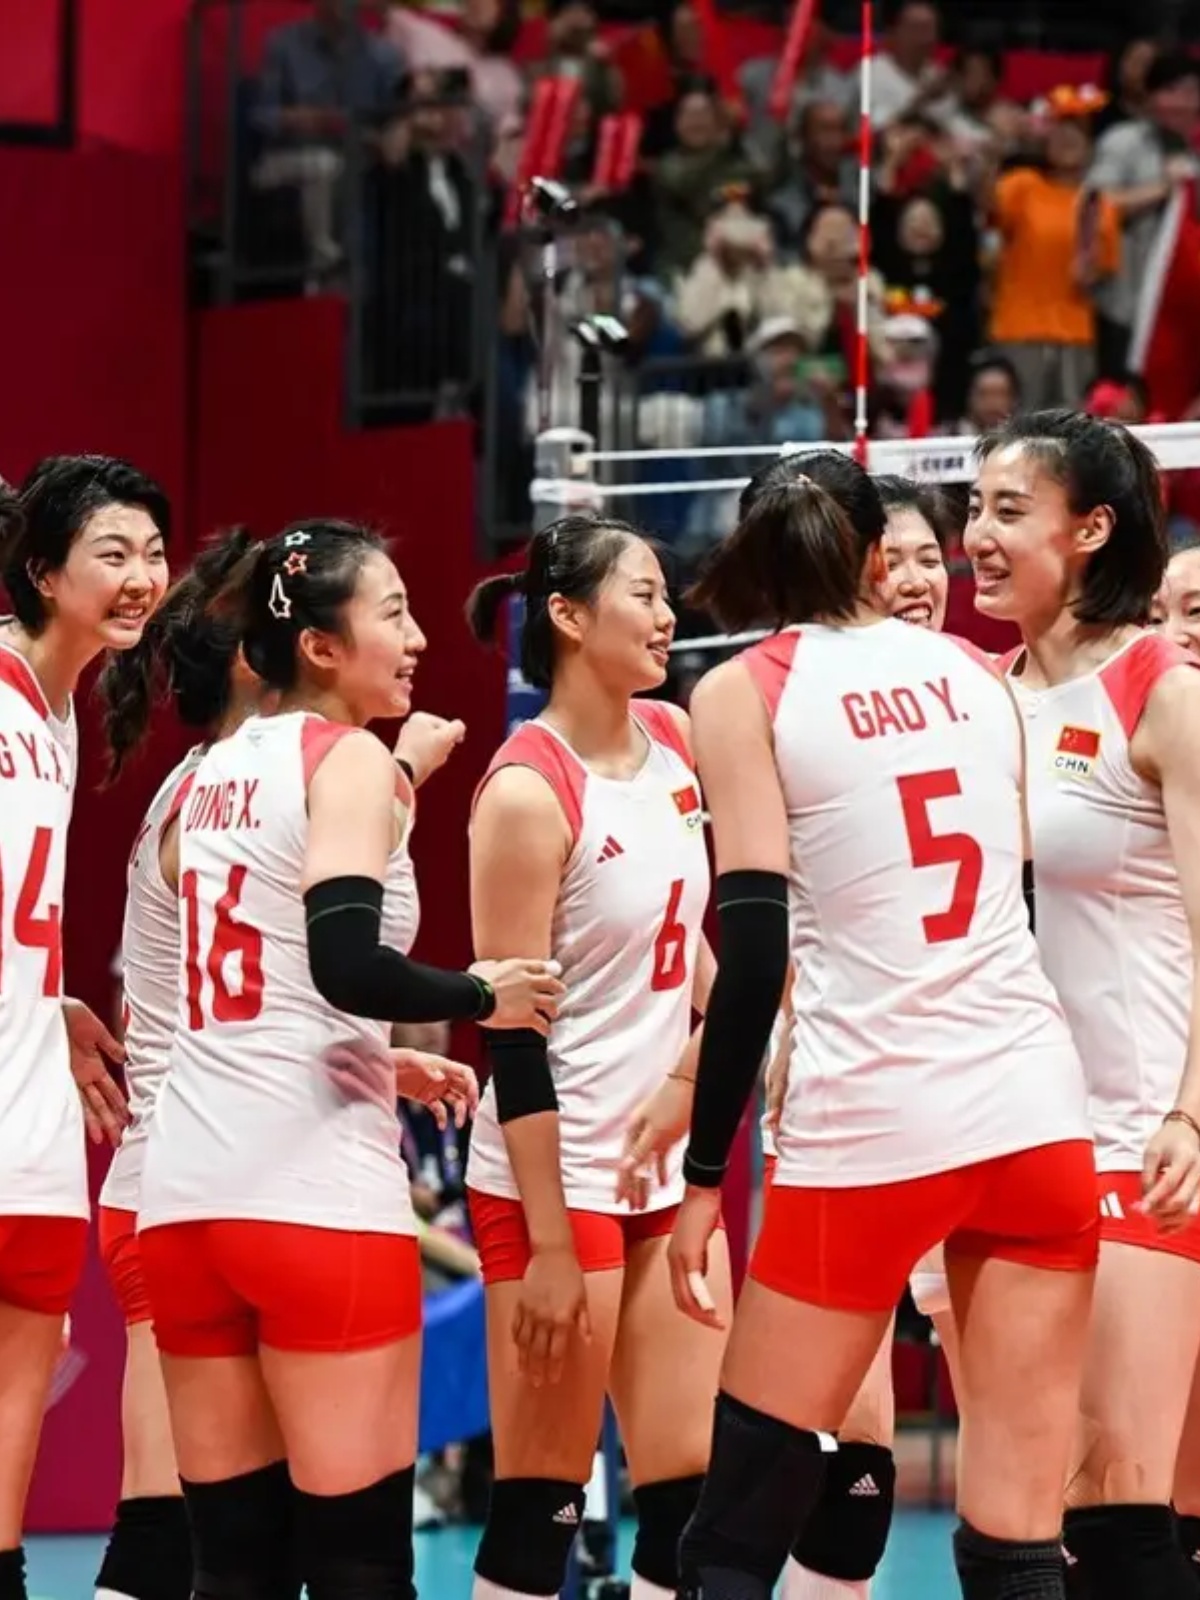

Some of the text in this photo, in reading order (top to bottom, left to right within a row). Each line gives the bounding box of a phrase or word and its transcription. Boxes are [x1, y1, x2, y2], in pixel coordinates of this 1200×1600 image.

[841, 677, 970, 740] GAO Y.
[1055, 756, 1088, 773] CHN
[184, 778, 261, 832] DING X.
[896, 767, 983, 944] 5
[0, 826, 59, 997] 4
[182, 864, 264, 1030] 16
[651, 879, 686, 992] 6
